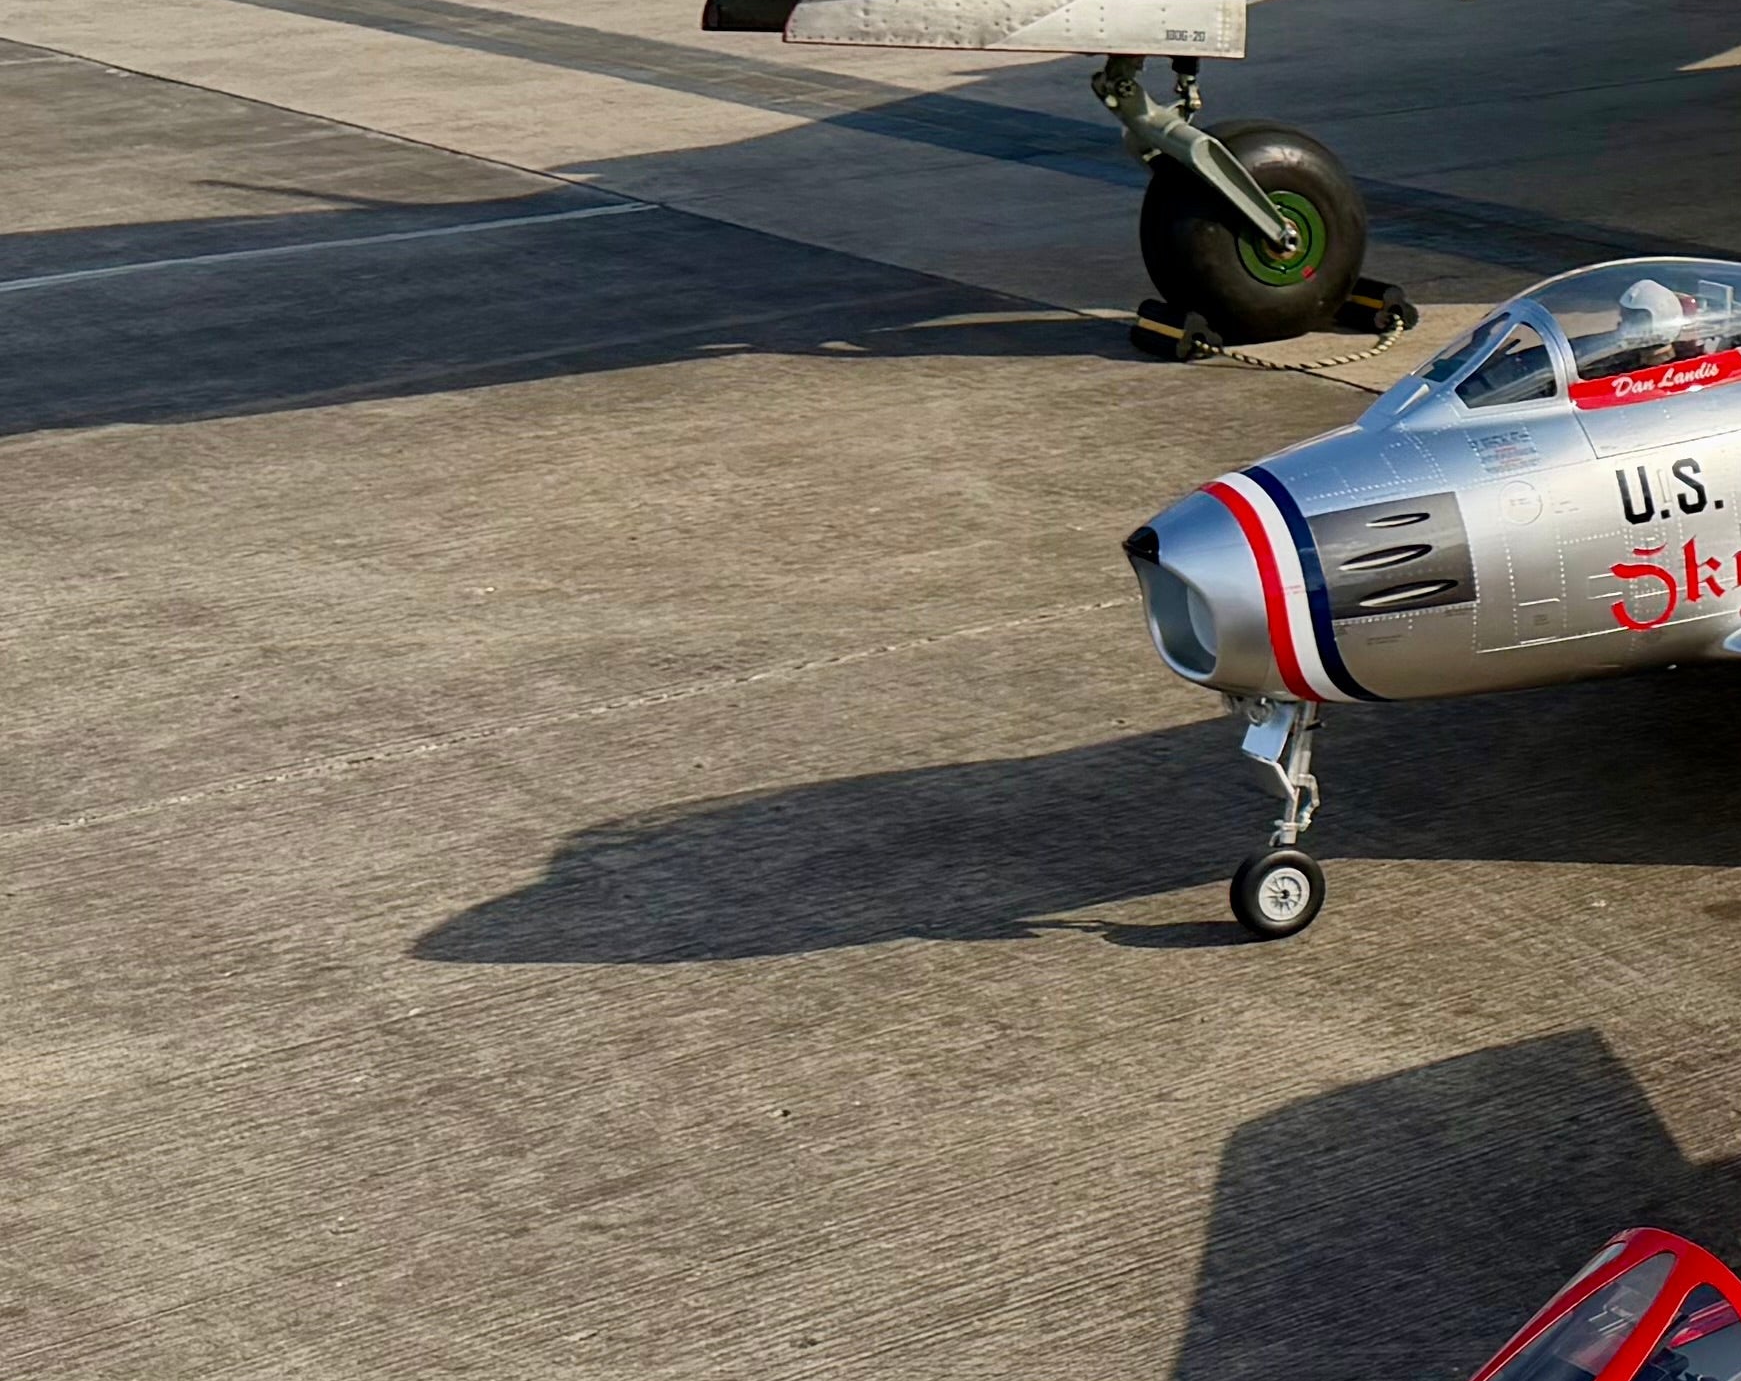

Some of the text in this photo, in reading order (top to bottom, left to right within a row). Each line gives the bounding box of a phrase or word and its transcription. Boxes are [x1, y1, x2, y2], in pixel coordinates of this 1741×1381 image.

[1611, 362, 1720, 398] Dan Landis
[1615, 457, 1725, 525] U.S.
